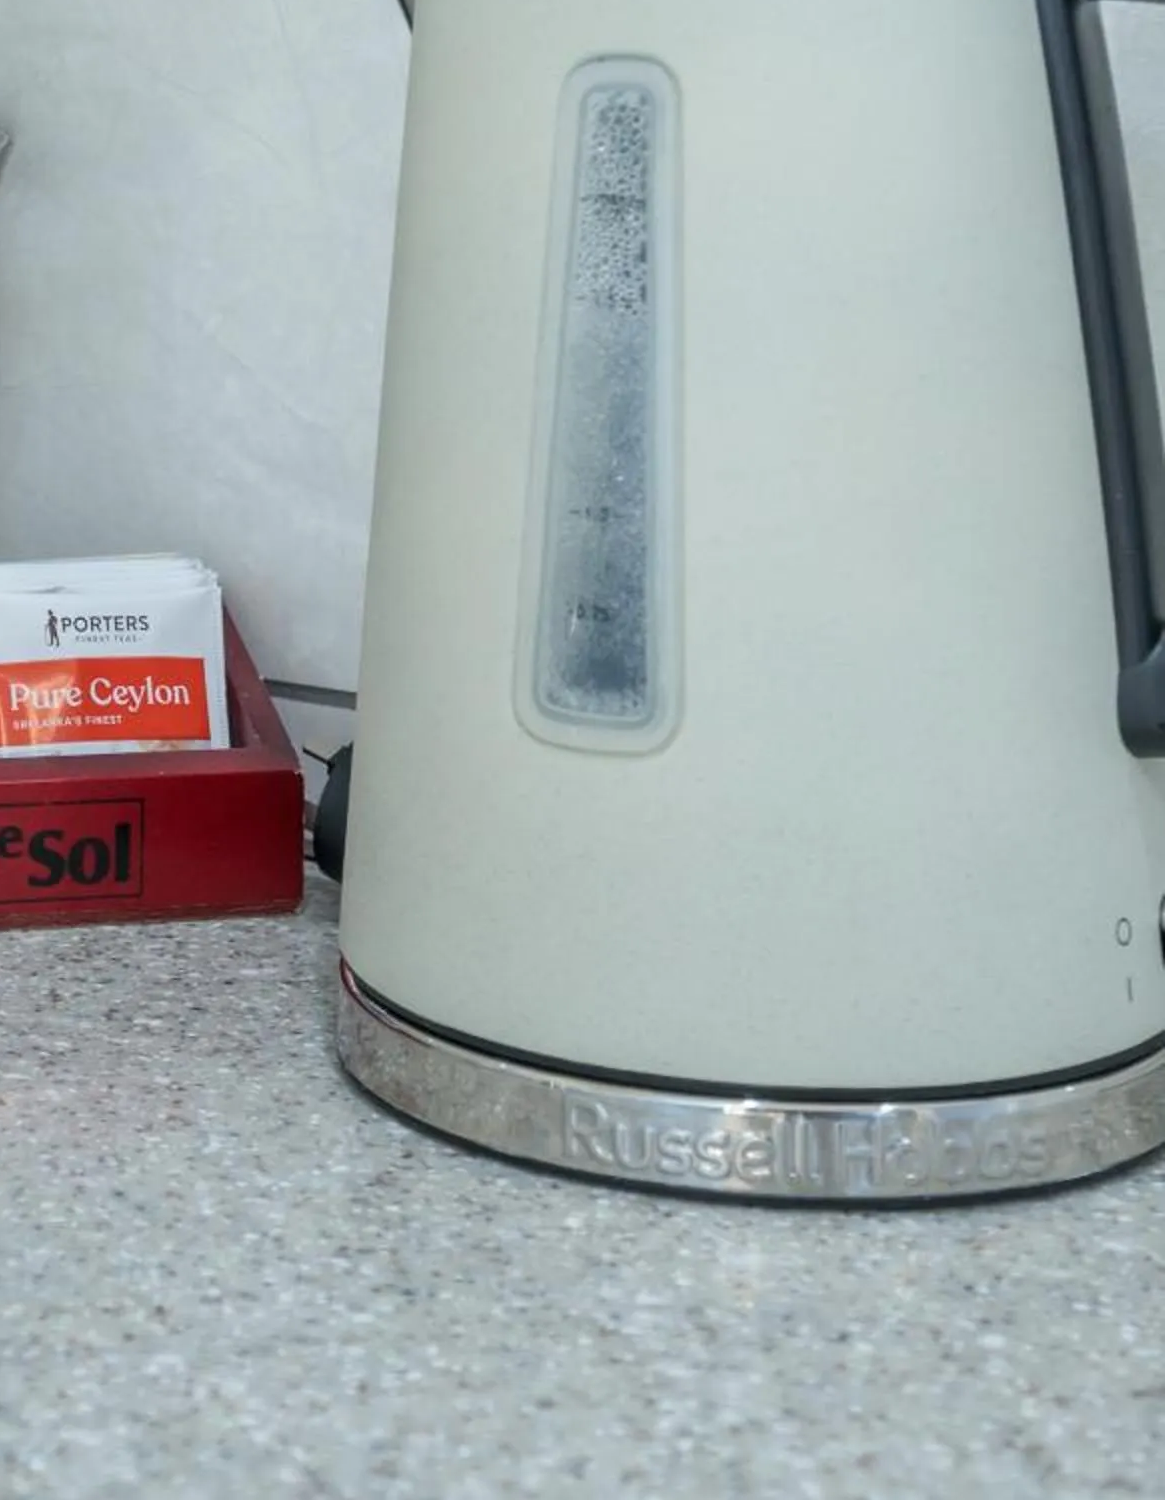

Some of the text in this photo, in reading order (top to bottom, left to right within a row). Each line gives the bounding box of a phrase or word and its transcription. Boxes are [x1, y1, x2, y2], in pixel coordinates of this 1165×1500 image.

[60, 615, 150, 633] PORTERS
[9, 675, 191, 713] Pure Ceylon
[27, 822, 132, 888] Sol
[562, 1090, 823, 1186] Russell
